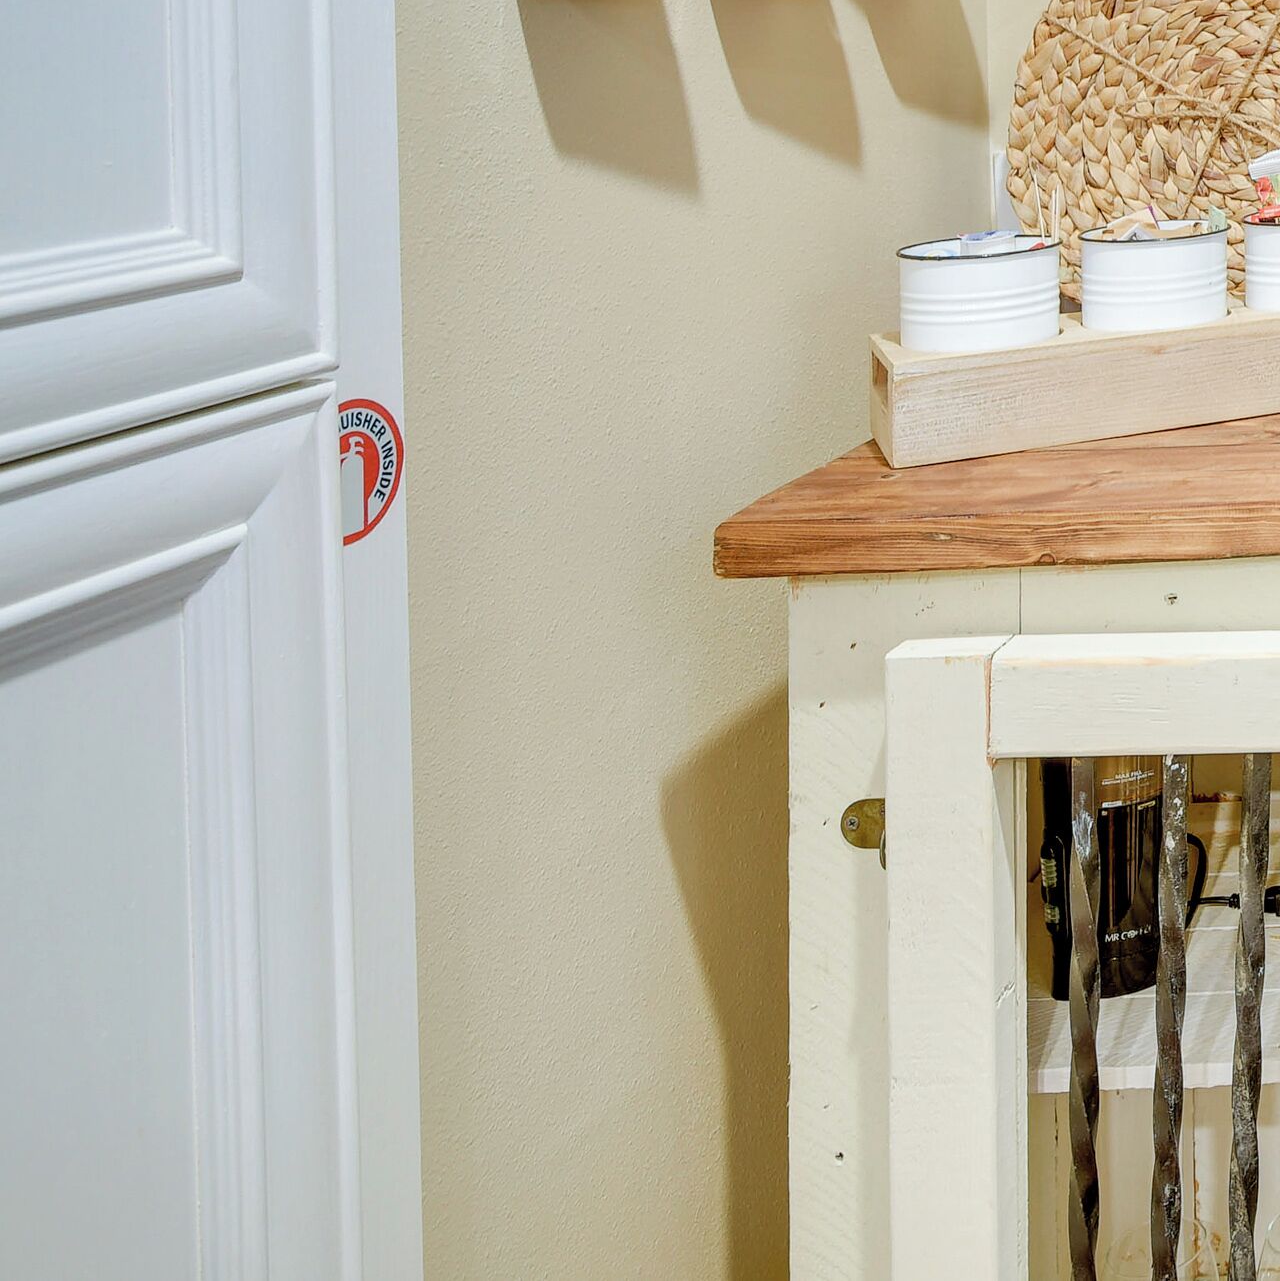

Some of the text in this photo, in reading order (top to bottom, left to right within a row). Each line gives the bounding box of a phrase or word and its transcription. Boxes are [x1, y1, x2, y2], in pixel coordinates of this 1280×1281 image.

[339, 411, 394, 503] UISHER INSIDE
[1105, 933, 1120, 943] MR
